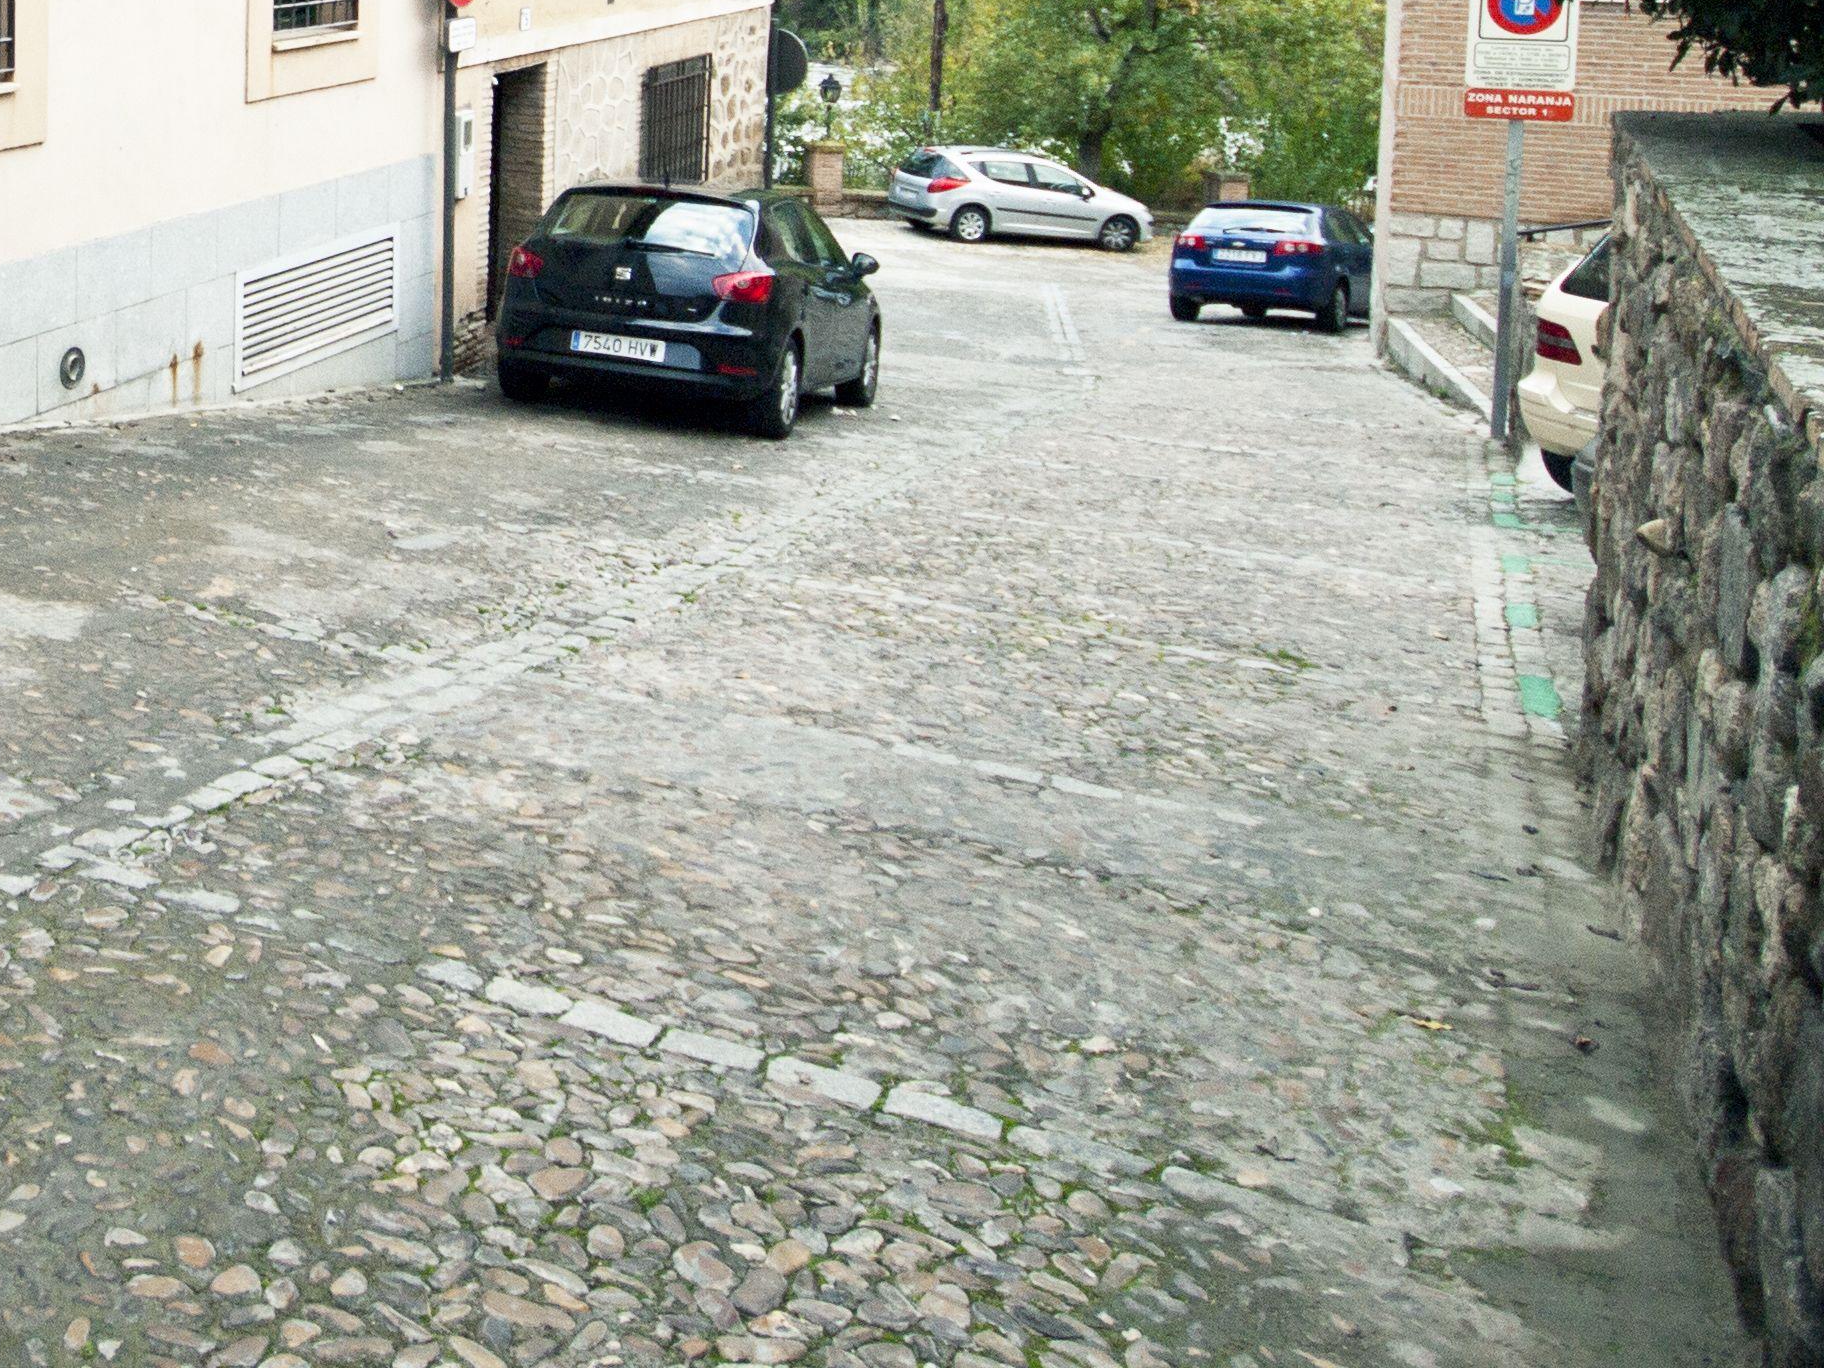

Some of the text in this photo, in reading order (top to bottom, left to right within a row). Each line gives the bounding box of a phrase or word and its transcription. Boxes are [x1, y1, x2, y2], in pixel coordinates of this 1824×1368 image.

[1467, 92, 1572, 107] ZONA NARANJA
[1486, 105, 1538, 116] SECTOR
[584, 334, 622, 353] 7540
